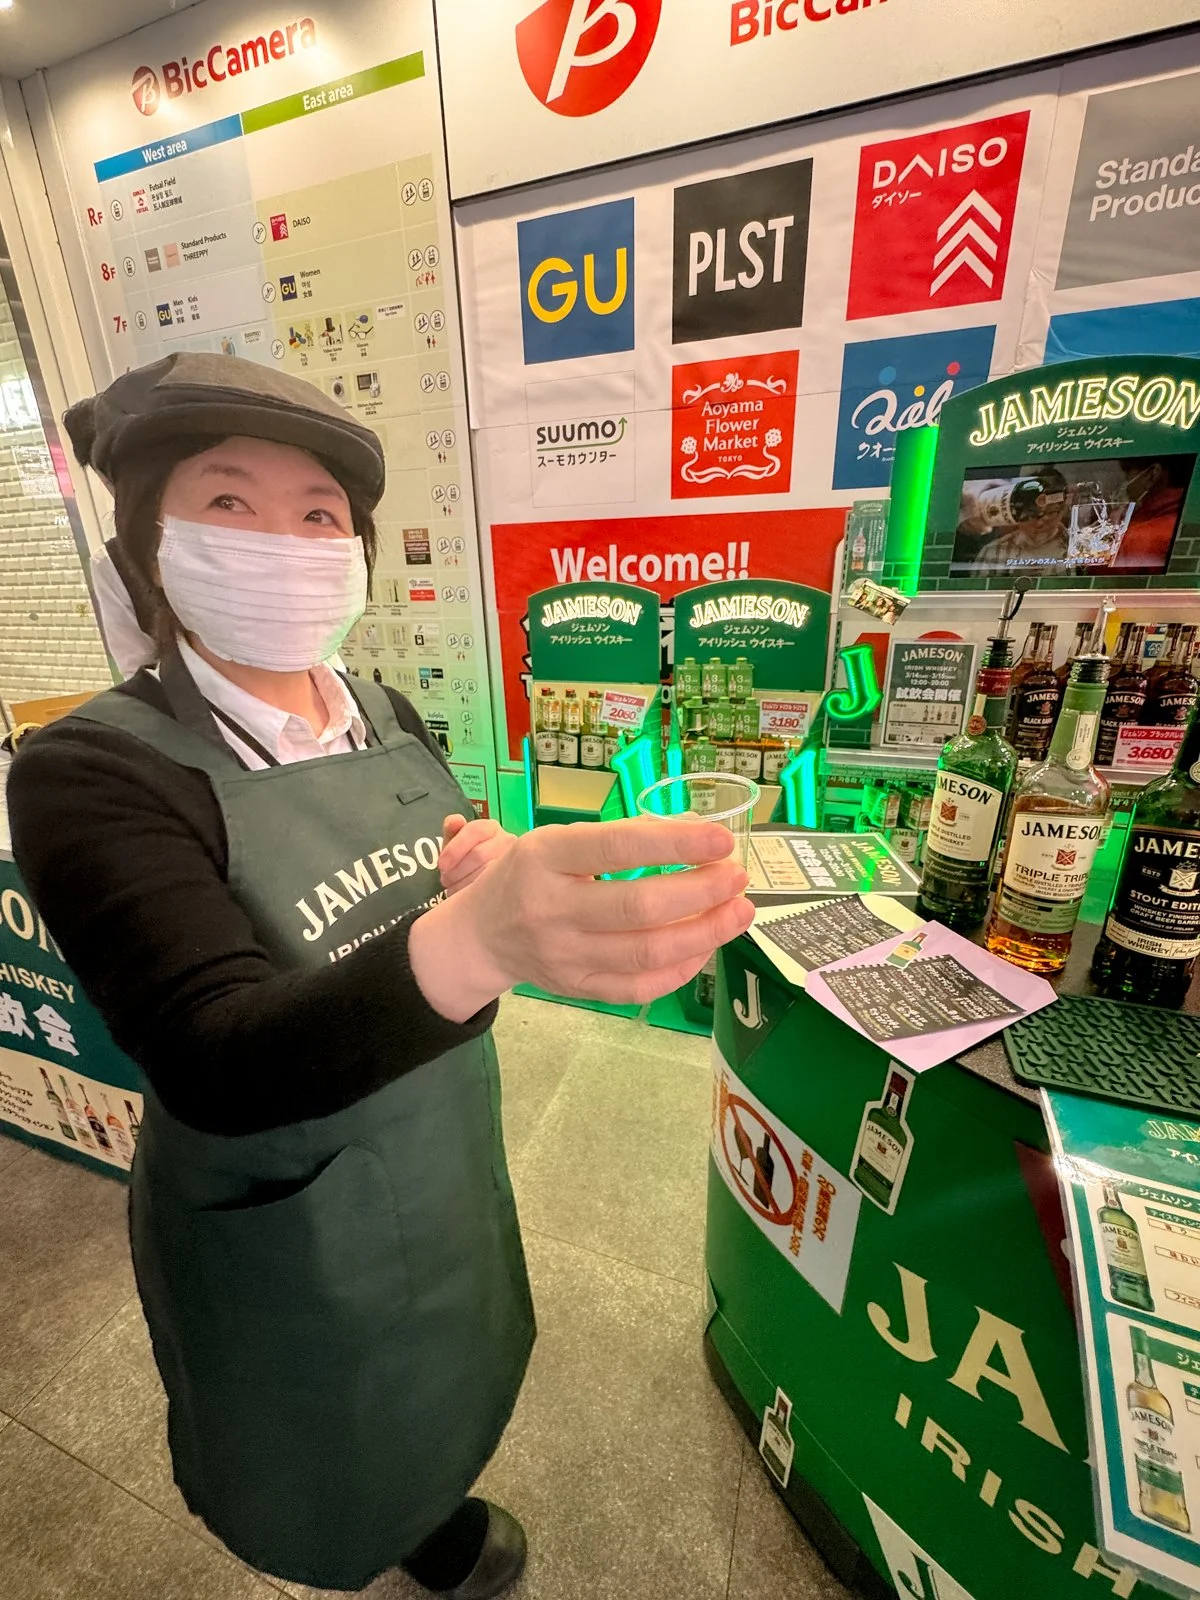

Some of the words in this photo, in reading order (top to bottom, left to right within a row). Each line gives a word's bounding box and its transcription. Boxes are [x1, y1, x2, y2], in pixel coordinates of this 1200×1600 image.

[163, 17, 318, 99] BicCamera
[303, 88, 326, 110] East
[329, 84, 353, 104] area
[142, 144, 164, 163] West
[165, 139, 187, 158] area
[872, 137, 1008, 189] DAISO
[149, 181, 163, 191] Futsal
[164, 177, 176, 187] Field
[872, 190, 922, 210] ダイソー
[293, 217, 311, 228] DAISO
[181, 237, 204, 250] Standard
[204, 232, 227, 244] Products
[183, 249, 209, 262] THREEPPY
[689, 215, 794, 296] PLST
[101, 263, 116, 281] 8F
[281, 282, 296, 295] GU
[300, 269, 321, 279] Women
[527, 247, 627, 323] GU
[173, 299, 184, 307] Men
[158, 310, 171, 321] GU
[114, 316, 128, 334] 7F
[701, 400, 764, 419] Aoyama
[969, 374, 1200, 447] JAMESON
[705, 418, 760, 435] Flower
[1057, 425, 1108, 439] ジェムソン
[703, 435, 759, 453] Market
[1027, 440, 1081, 454] アイリッシュ
[1084, 437, 1134, 450] ウイスキー
[537, 451, 617, 468] スーモカウンター
[718, 454, 743, 463] TOKYO
[550, 541, 750, 583] Welcome!!
[541, 595, 643, 628] JAMESON
[689, 595, 810, 628] JAMESON
[571, 623, 611, 633] ジェムソン
[723, 624, 770, 635] ジェムソン
[550, 635, 592, 645] アイリッシュ
[594, 635, 633, 645] ウイスキー
[698, 637, 747, 648] アイリッシュ
[750, 638, 795, 649] ウイスキー
[901, 647, 964, 663] JAMESON
[896, 687, 962, 702] 試飲会開催
[1105, 695, 1146, 706] JAMESON
[1023, 717, 1041, 725] BLACK
[1122, 730, 1147, 738] ジェムソン
[1127, 745, 1174, 760] 3,680
[1021, 821, 1100, 840] JAMESO
[1134, 836, 1200, 859] JAME
[851, 840, 902, 887] JAMESON
[1015, 863, 1061, 882] TRIPLE
[296, 836, 445, 942] JAMESO
[1129, 889, 1169, 908] STOUT
[1130, 908, 1154, 920] CRAFT
[1155, 916, 1176, 924] BEER
[1133, 903, 1167, 917] WHISKEY
[1127, 939, 1170, 955] WHISKEY
[1137, 937, 1162, 948] IRISH
[733, 968, 768, 1030] J
[867, 1124, 901, 1155] JAMESON
[1138, 1187, 1192, 1208] ジェムソン
